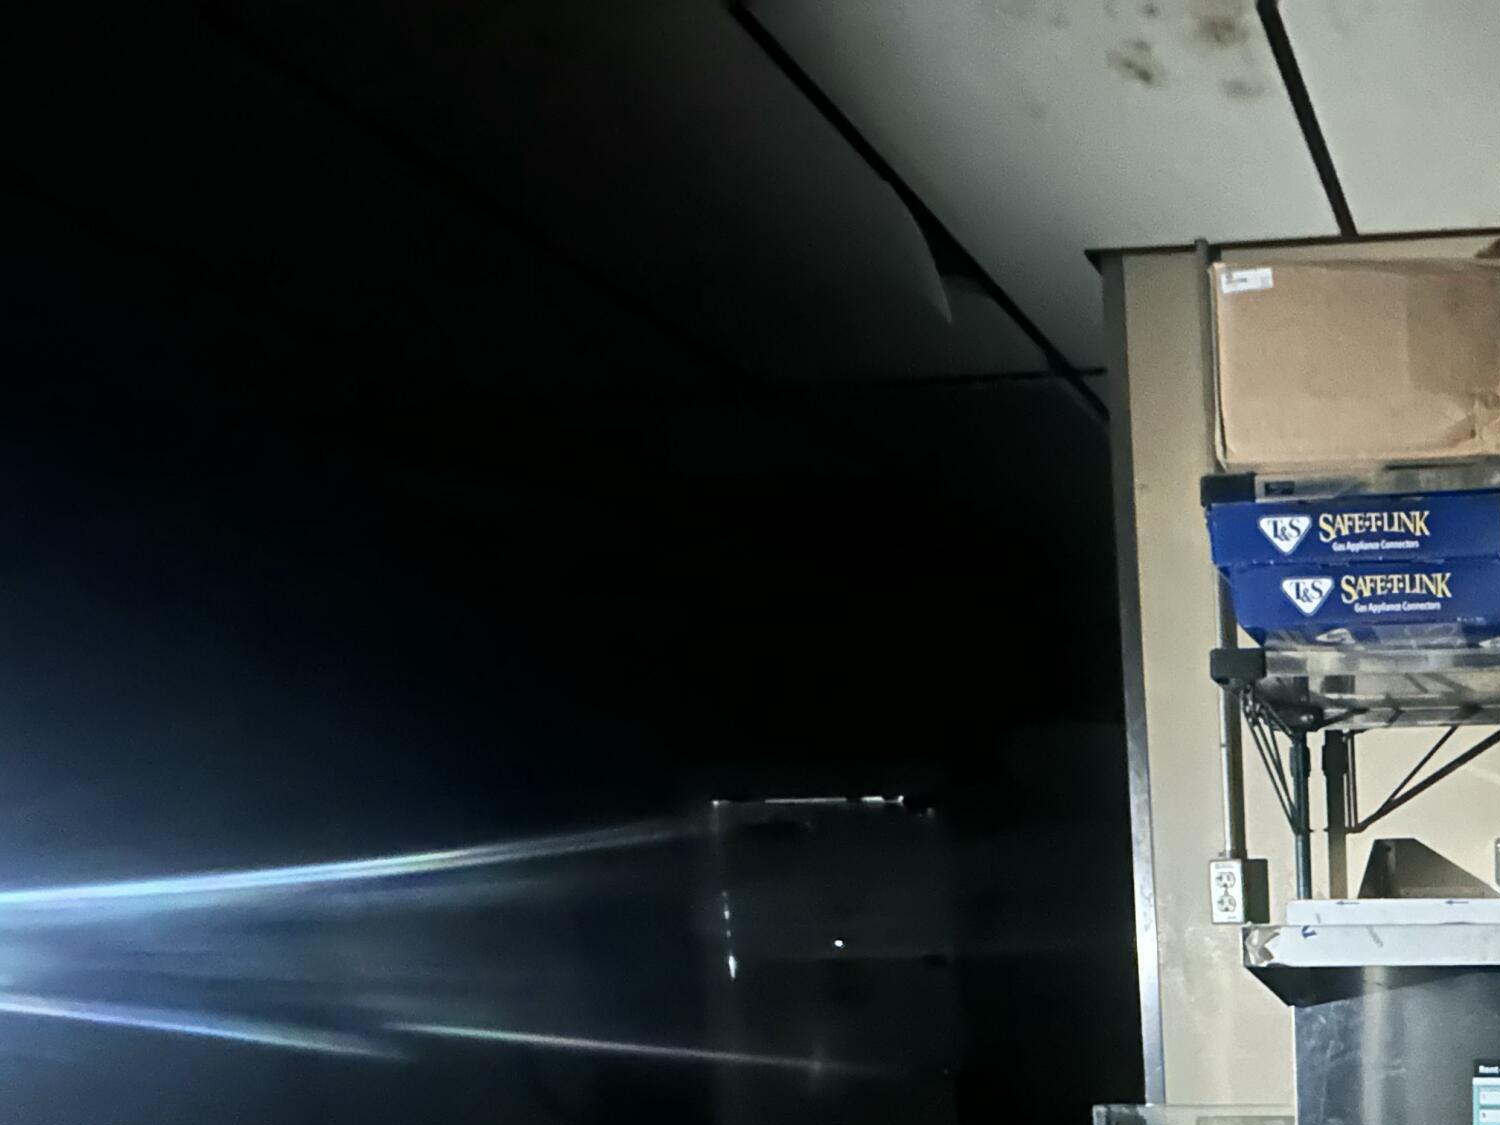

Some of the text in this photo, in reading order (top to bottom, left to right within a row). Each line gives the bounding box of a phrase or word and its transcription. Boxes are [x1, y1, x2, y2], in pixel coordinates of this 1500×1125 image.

[1267, 520, 1301, 541] T&S
[1346, 540, 1380, 553] Appliance
[1380, 539, 1420, 550] Connectors
[1291, 580, 1324, 603] T&S
[1368, 602, 1401, 614] Appliance
[1402, 601, 1441, 612] Connectors
